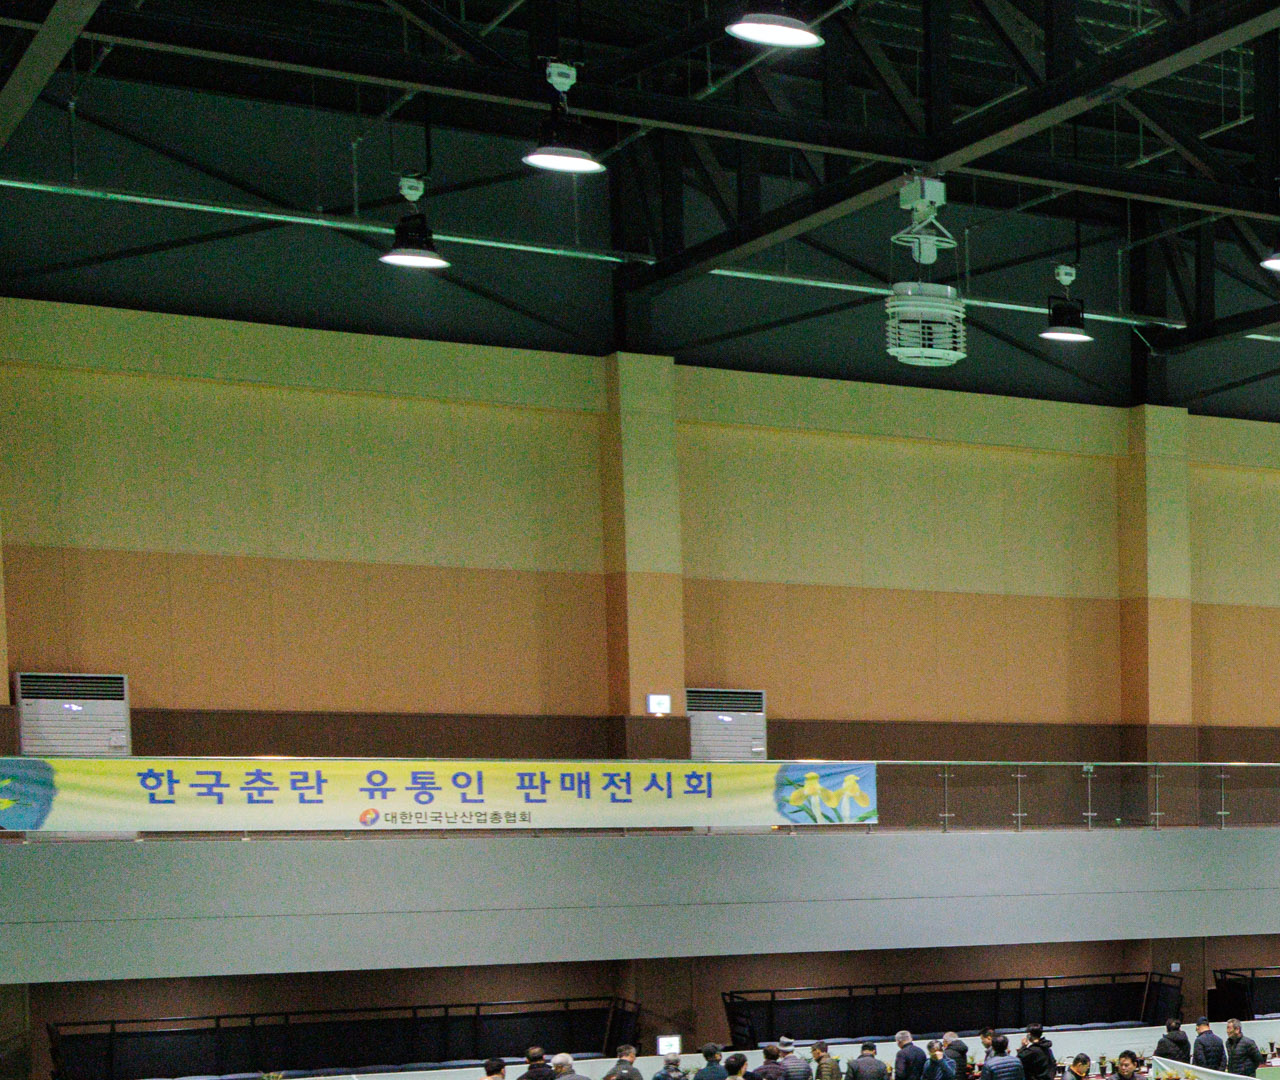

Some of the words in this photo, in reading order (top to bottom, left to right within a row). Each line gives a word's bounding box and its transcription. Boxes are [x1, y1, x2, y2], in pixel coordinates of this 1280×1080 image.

[137, 768, 329, 805] 한국춘란
[359, 769, 484, 805] 유통인
[516, 770, 713, 804] 판매전시회
[384, 810, 532, 826] 대한민국난산업총협회
